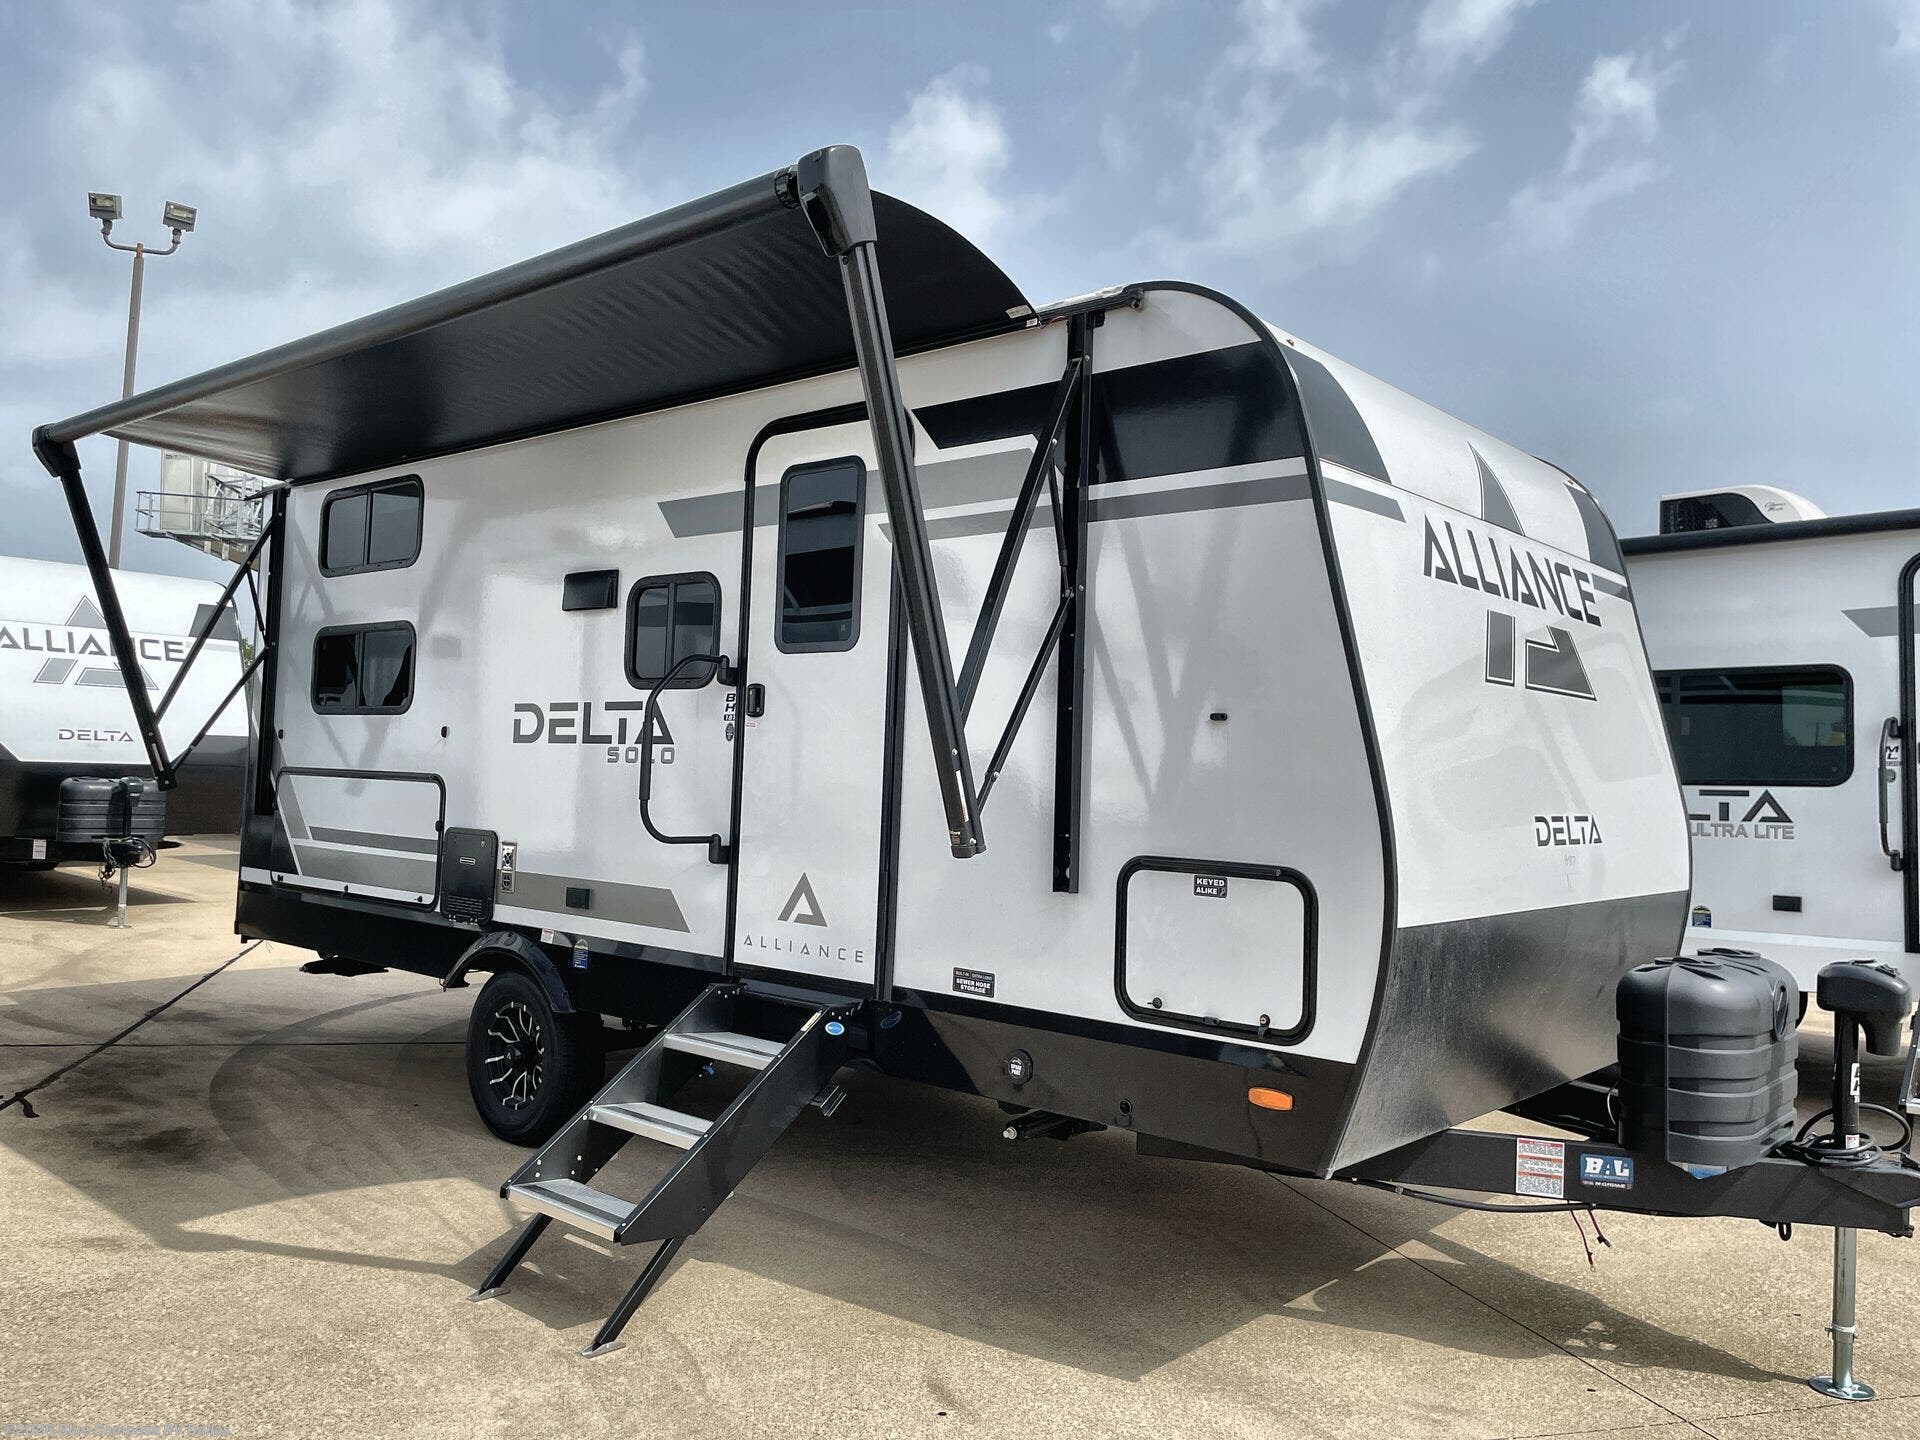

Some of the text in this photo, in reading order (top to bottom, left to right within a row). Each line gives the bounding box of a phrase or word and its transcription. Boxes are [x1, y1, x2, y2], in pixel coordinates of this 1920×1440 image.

[1424, 513, 1602, 627] ALLIANCE
[512, 699, 675, 744] DELTA
[58, 728, 134, 742] DELTA
[607, 746, 675, 764] SOO
[1534, 815, 1602, 847] DELTA
[1754, 824, 1795, 839] LITE
[1197, 878, 1224, 887] KEYED
[743, 934, 864, 963] ALLIANCE
[956, 978, 991, 989] SEWER HOSE
[960, 984, 986, 994] STORAGE
